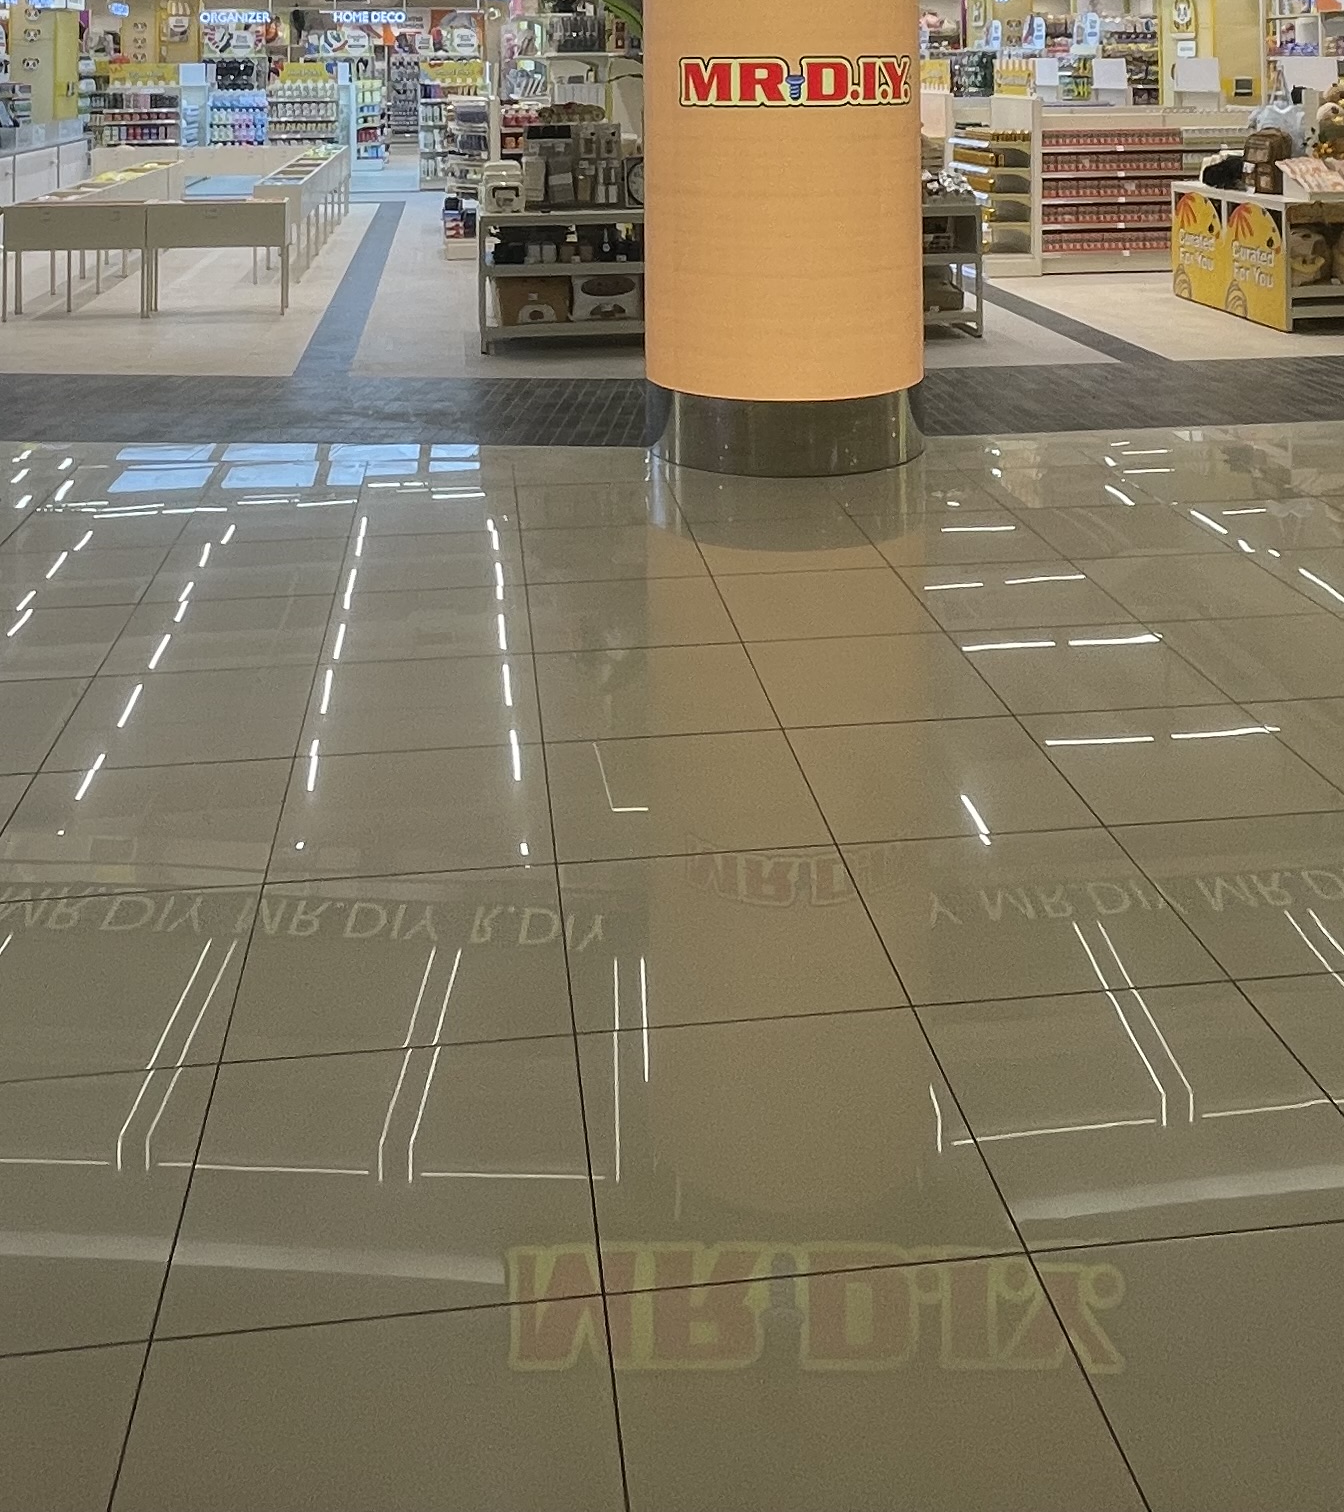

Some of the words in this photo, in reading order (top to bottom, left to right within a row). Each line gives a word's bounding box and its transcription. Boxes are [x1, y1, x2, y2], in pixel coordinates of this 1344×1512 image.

[199, 11, 272, 24] ORGANIZER
[332, 10, 369, 24] HOME
[370, 10, 406, 24] DECO
[1231, 239, 1275, 268] Curated
